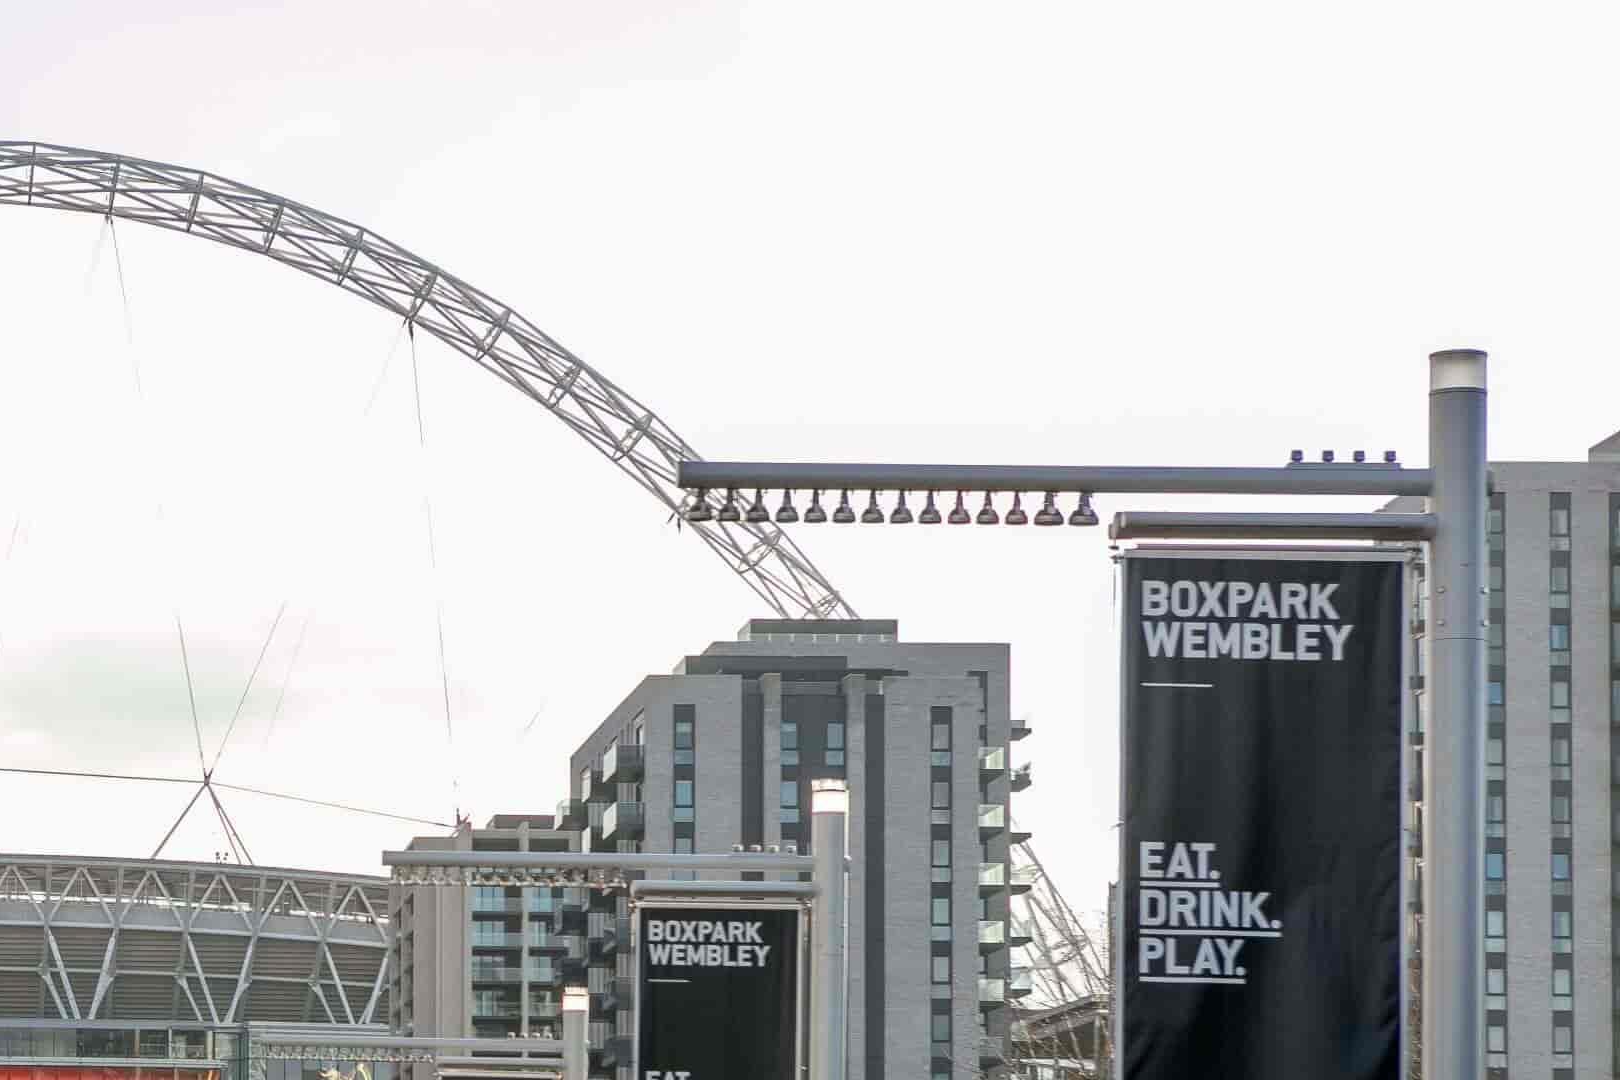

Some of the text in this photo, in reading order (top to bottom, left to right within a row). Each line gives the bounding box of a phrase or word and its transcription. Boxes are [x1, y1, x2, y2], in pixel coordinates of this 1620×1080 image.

[1141, 580, 1341, 620] BOXPARK
[1142, 622, 1355, 661] WEMBLEY
[1139, 841, 1220, 879] EAT.
[1139, 890, 1282, 929] DRINK.
[647, 920, 764, 943] BOXPARK
[648, 944, 771, 967] WEMBLEY
[1139, 938, 1246, 977] PLAY.
